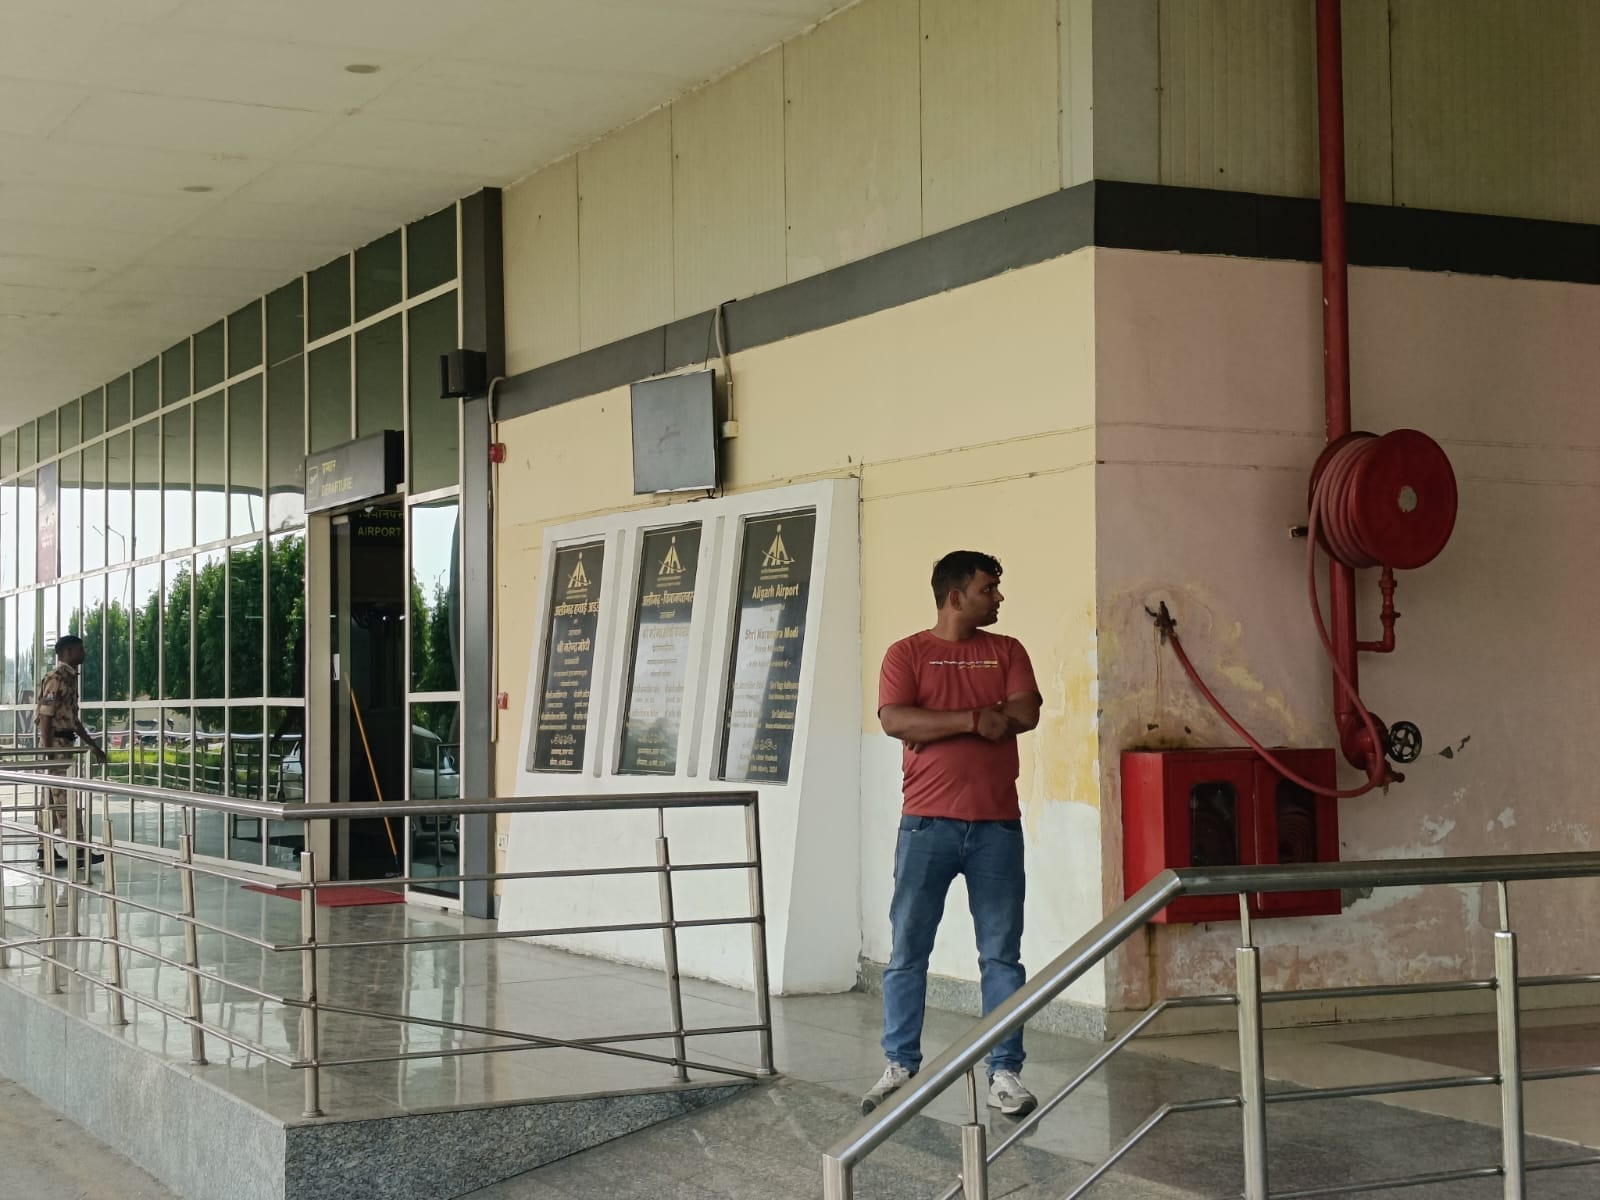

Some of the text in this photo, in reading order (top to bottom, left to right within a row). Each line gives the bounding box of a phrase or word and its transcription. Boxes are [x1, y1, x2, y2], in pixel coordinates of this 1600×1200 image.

[322, 477, 353, 497] DEPARTURE
[358, 527, 402, 537] AIRPORT
[752, 583, 799, 601] Aligarh Airport
[784, 626, 799, 639] Modi
